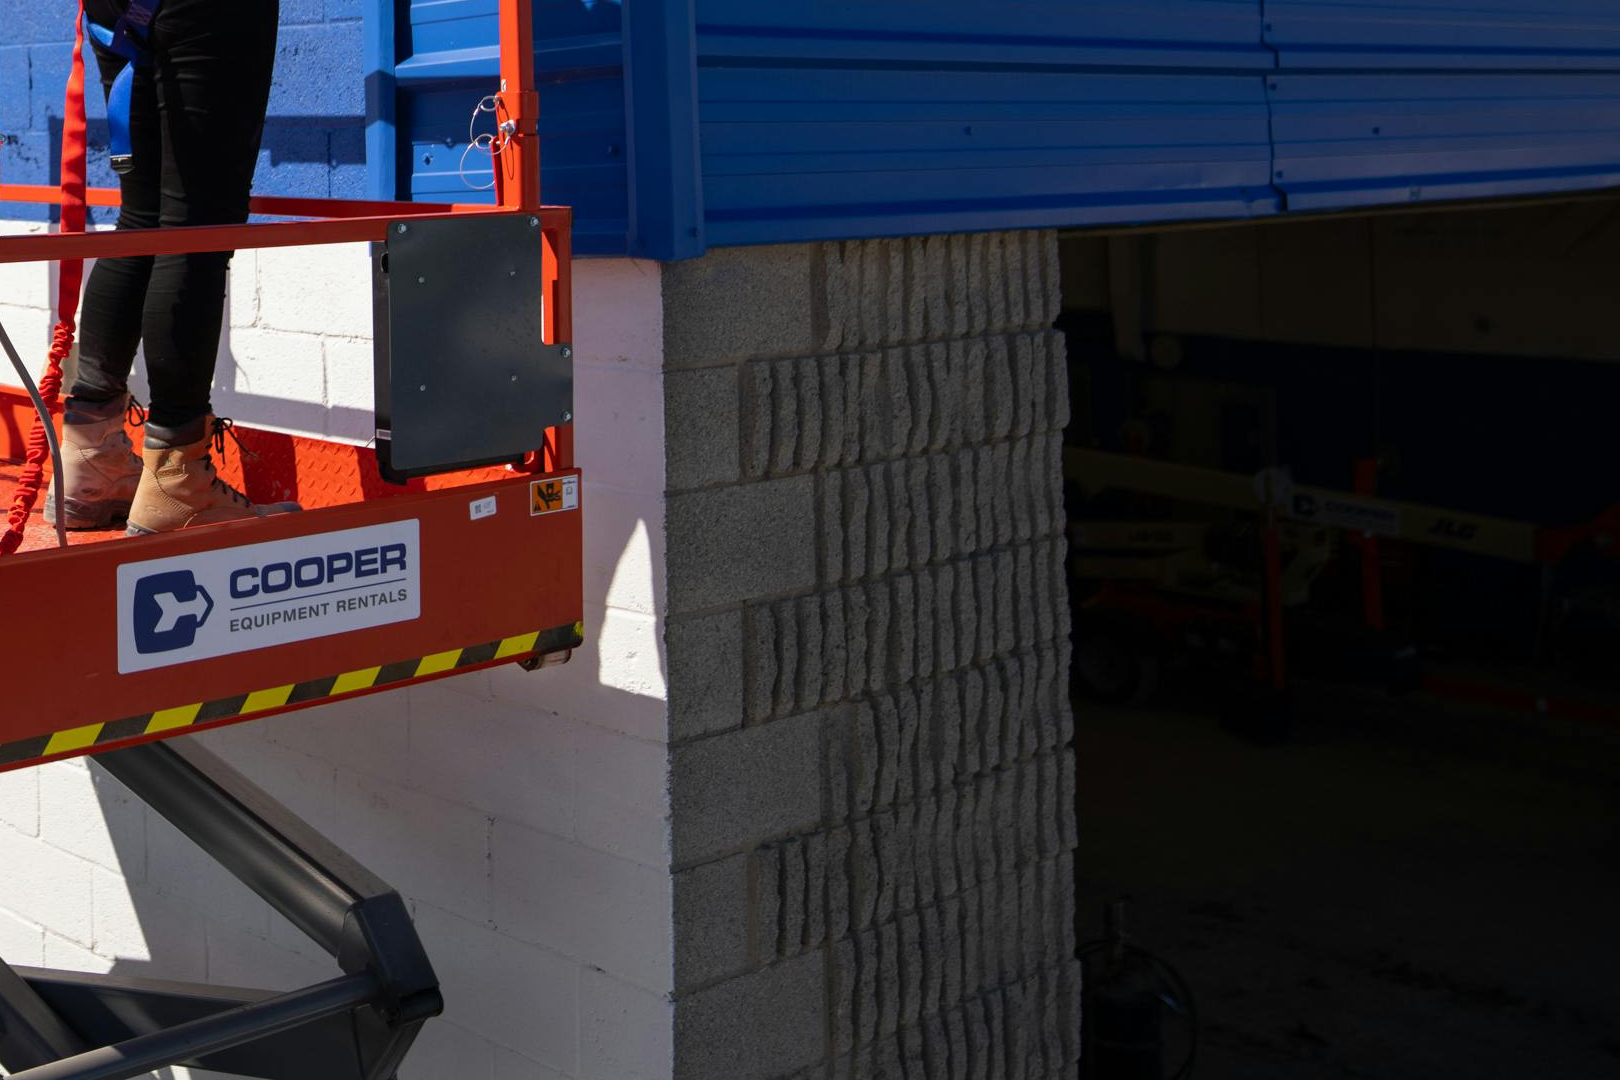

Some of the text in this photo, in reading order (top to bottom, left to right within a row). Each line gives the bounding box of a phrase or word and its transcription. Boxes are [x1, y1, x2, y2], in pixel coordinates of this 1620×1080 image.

[229, 542, 407, 599] COOPER
[230, 588, 408, 633] EQUIPMENT RENTALS
